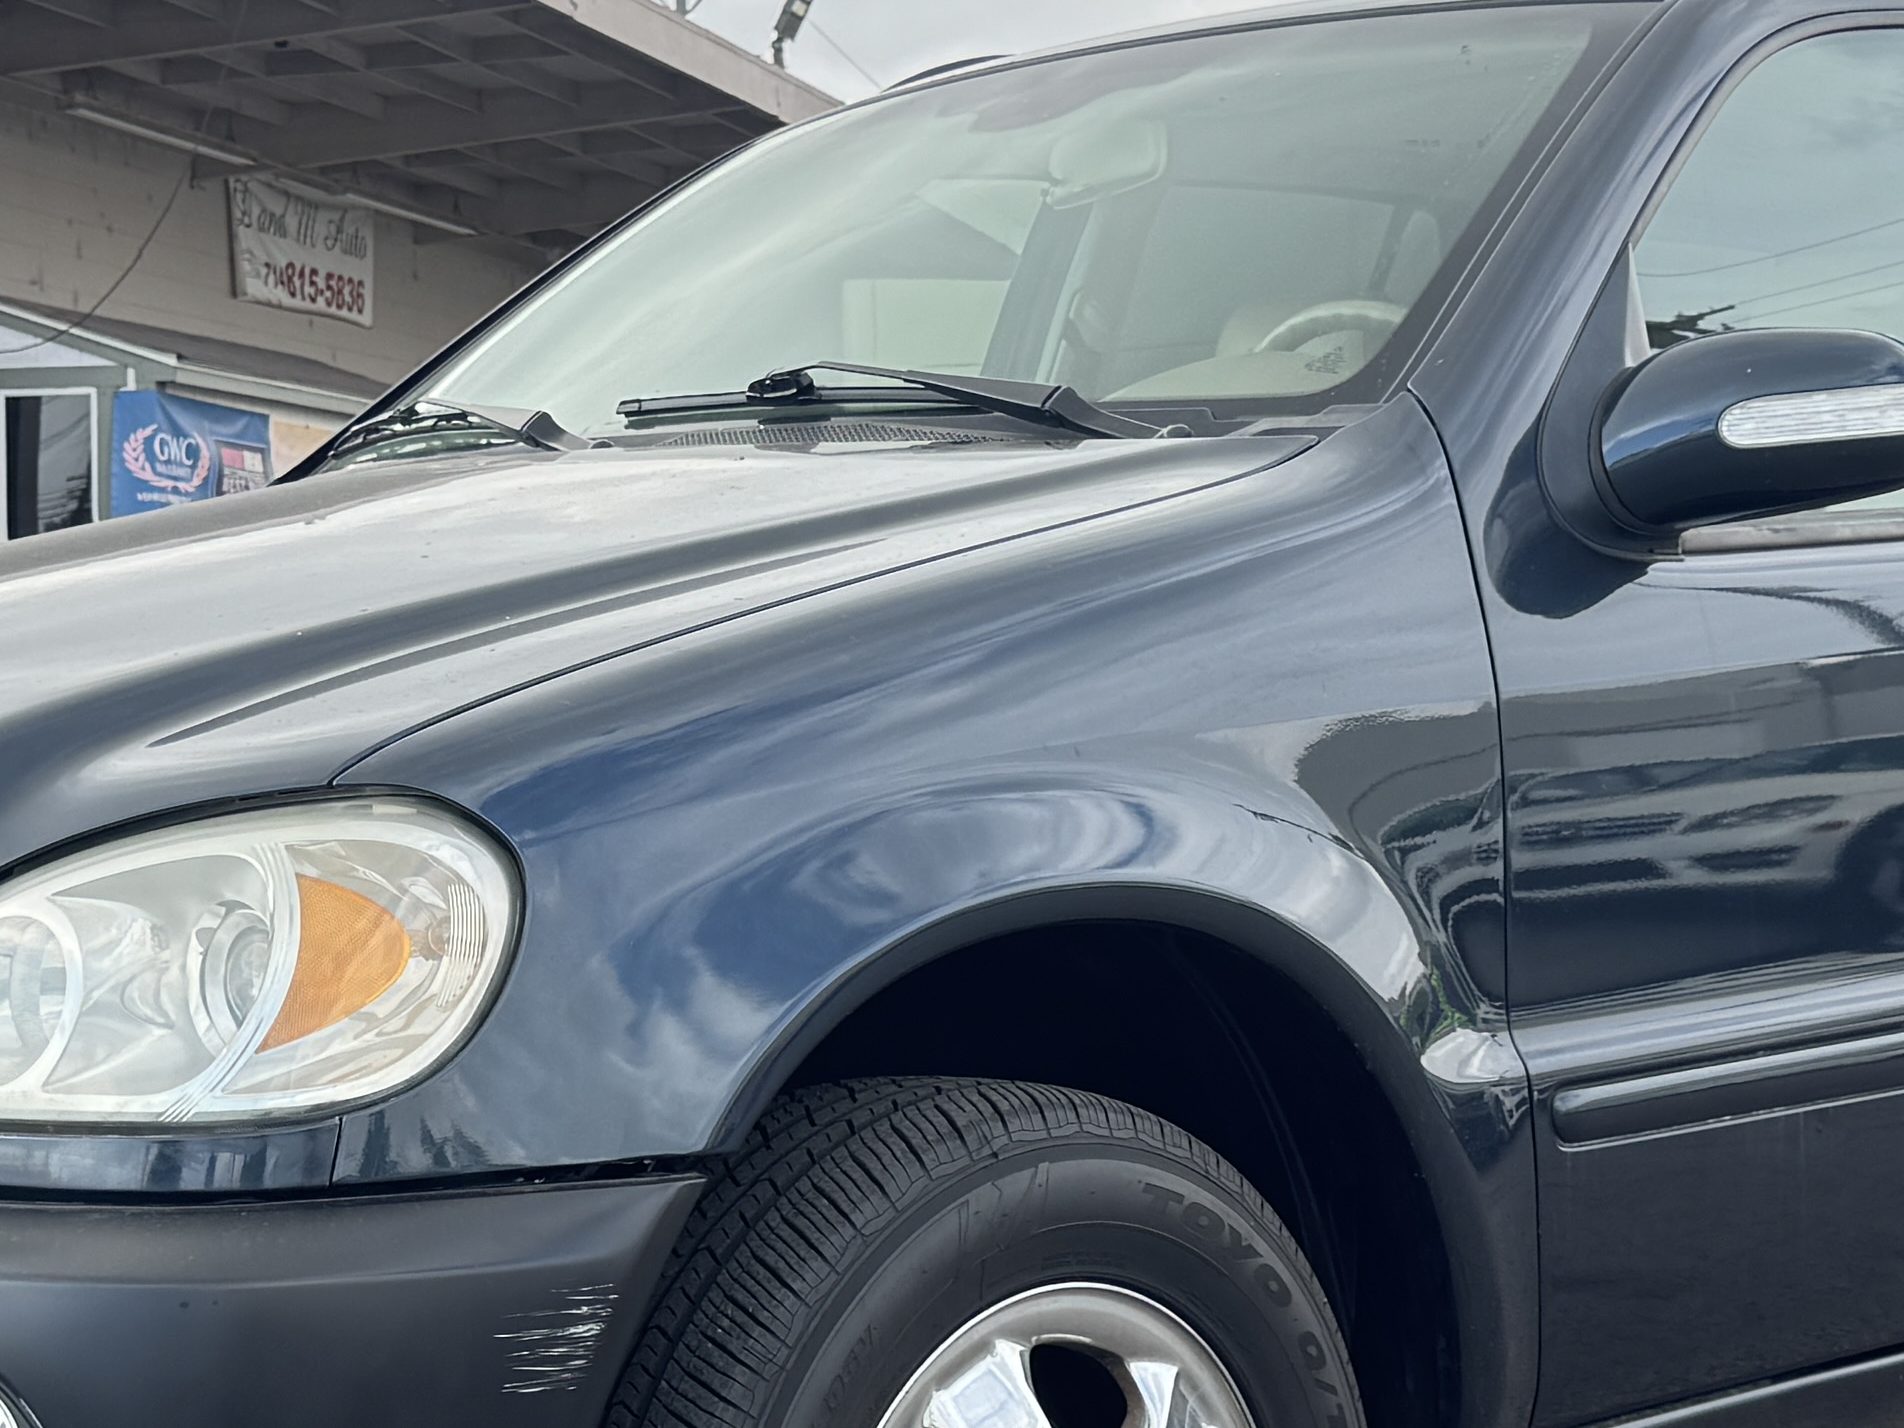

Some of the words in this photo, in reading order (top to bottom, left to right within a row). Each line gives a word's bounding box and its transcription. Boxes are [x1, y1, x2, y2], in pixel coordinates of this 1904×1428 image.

[257, 190, 291, 239] and
[324, 208, 367, 260] Auto
[153, 432, 196, 466] GWC
[1142, 1182, 1293, 1308] TOYO
